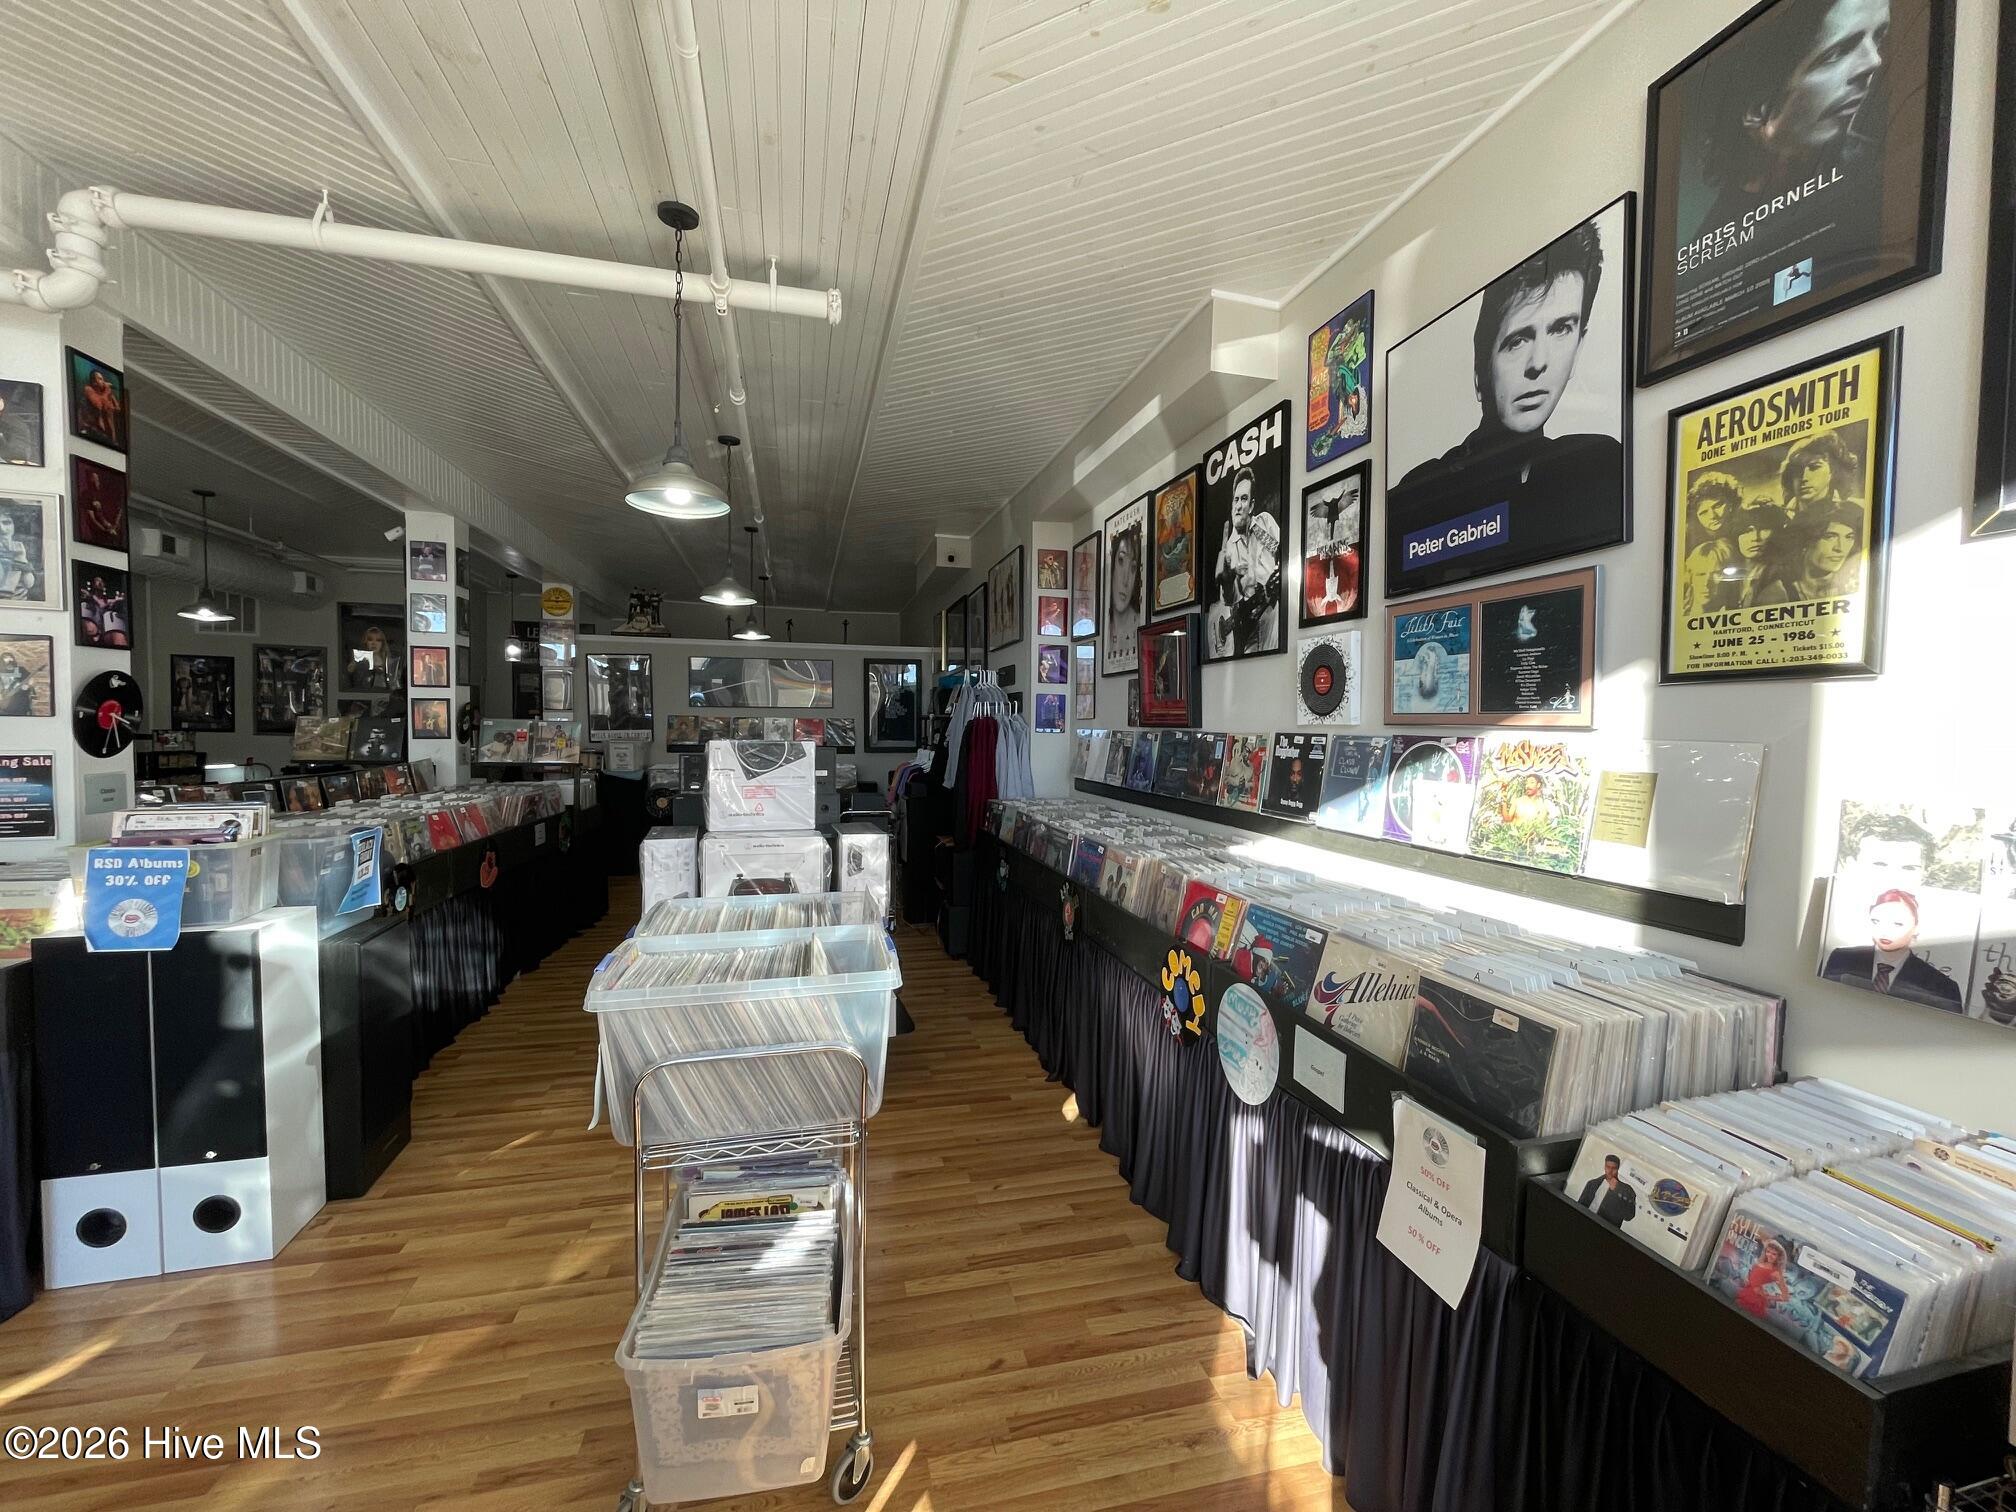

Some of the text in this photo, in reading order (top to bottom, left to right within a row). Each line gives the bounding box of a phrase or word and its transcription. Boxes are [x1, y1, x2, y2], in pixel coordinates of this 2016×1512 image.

[1677, 221, 1735, 262] CHRIS
[1743, 167, 1844, 228] CORNELL
[1677, 226, 1755, 275] SCREAM
[1697, 364, 1860, 450] AEROSMITH
[1206, 409, 1283, 485] CASH
[1701, 407, 1850, 462] DONE WITH MIRRORS TOUR
[1409, 514, 1501, 559] Peter Gabriel
[1434, 611, 1466, 633] Fair
[1687, 599, 1850, 631] CIVIC CENTER
[1713, 619, 1816, 636] HARTFORD, CONNECTICUT
[1712, 637, 1743, 649] JUNE
[1748, 635, 1765, 645] 25
[1783, 630, 1816, 642] 1986
[1686, 662, 1701, 670] FOR
[1702, 659, 1753, 669] INFORMATION
[1756, 657, 1778, 665] CALL:
[0, 756, 52, 769] ng Sale
[94, 857, 184, 869] RSD Albums
[105, 874, 139, 887] 30%
[1473, 972, 1481, 982] A
[1420, 1165, 1451, 1191] 50% OFF
[1406, 1180, 1463, 1227] Classical & Opera
[1417, 1203, 1443, 1228] Albums
[1407, 1225, 1441, 1256] 50 % OFF
[1730, 1212, 1763, 1244] KYLIE
